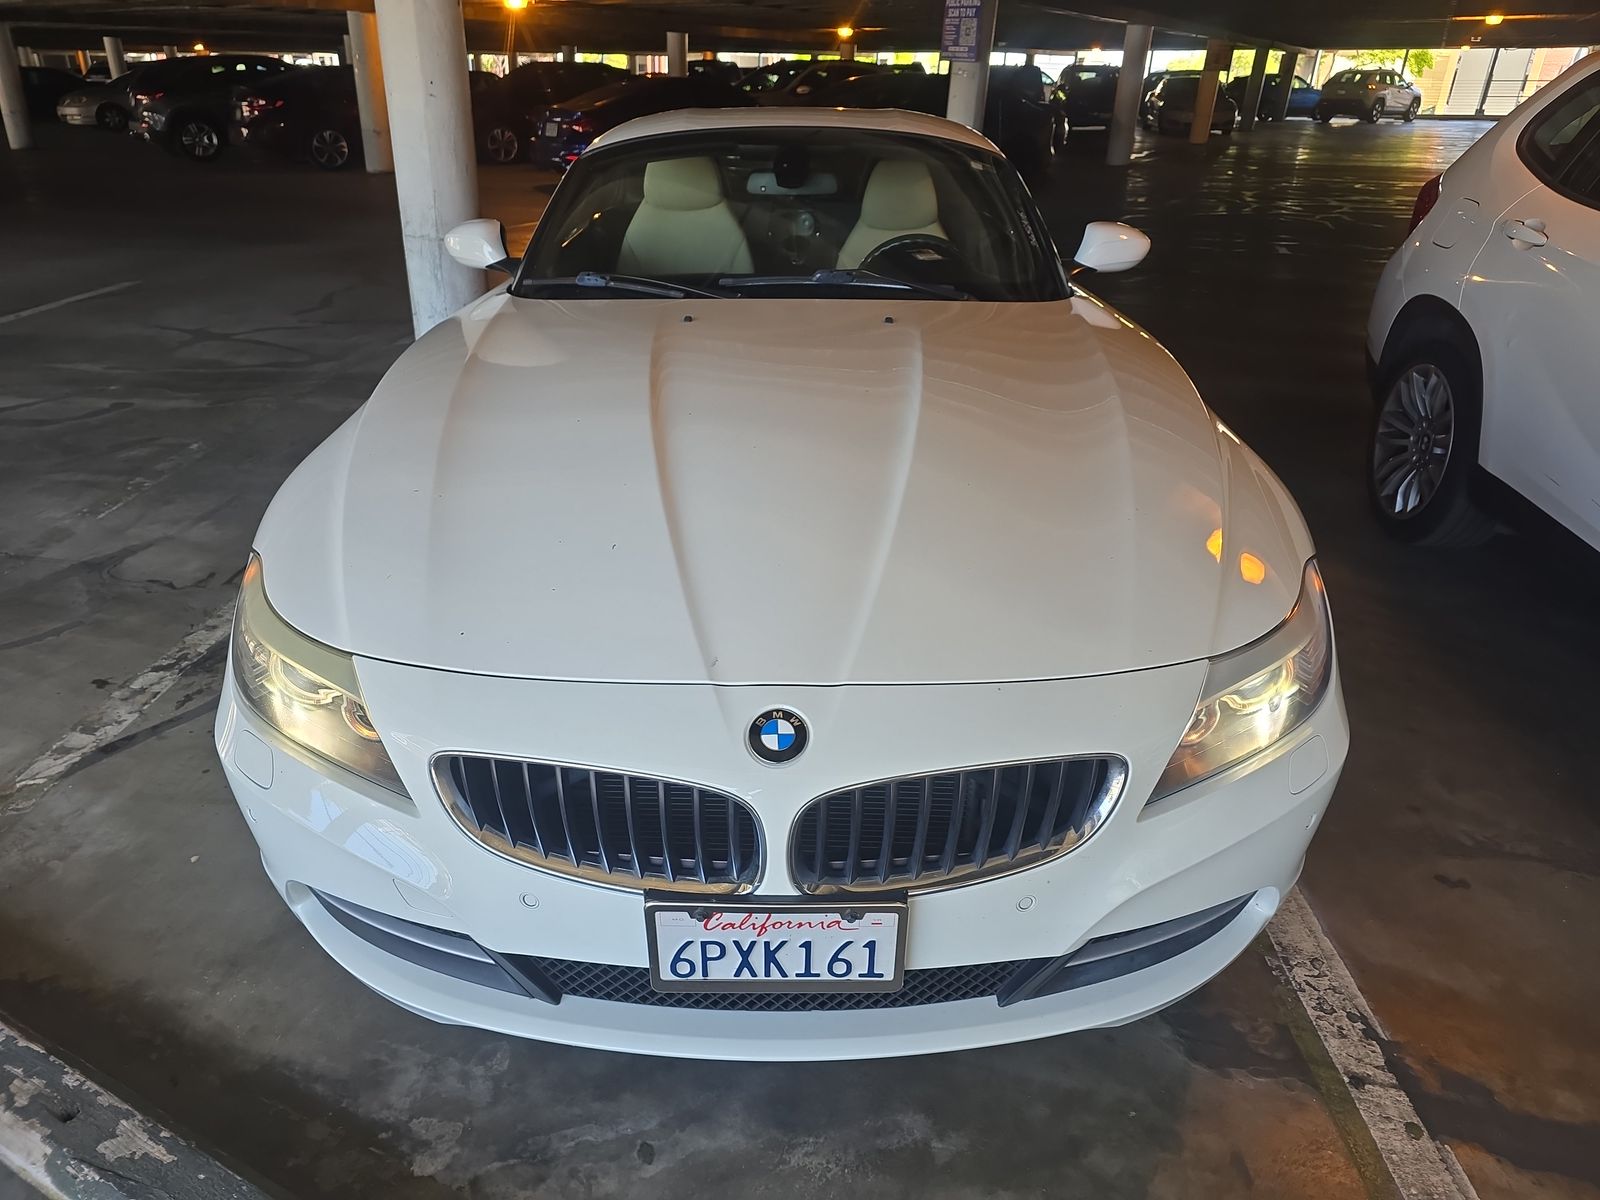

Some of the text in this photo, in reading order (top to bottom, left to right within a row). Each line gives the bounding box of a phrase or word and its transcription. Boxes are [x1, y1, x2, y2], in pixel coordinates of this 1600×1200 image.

[755, 711, 801, 727] BMW
[703, 911, 859, 937] California
[669, 939, 884, 979] 6PXK161
